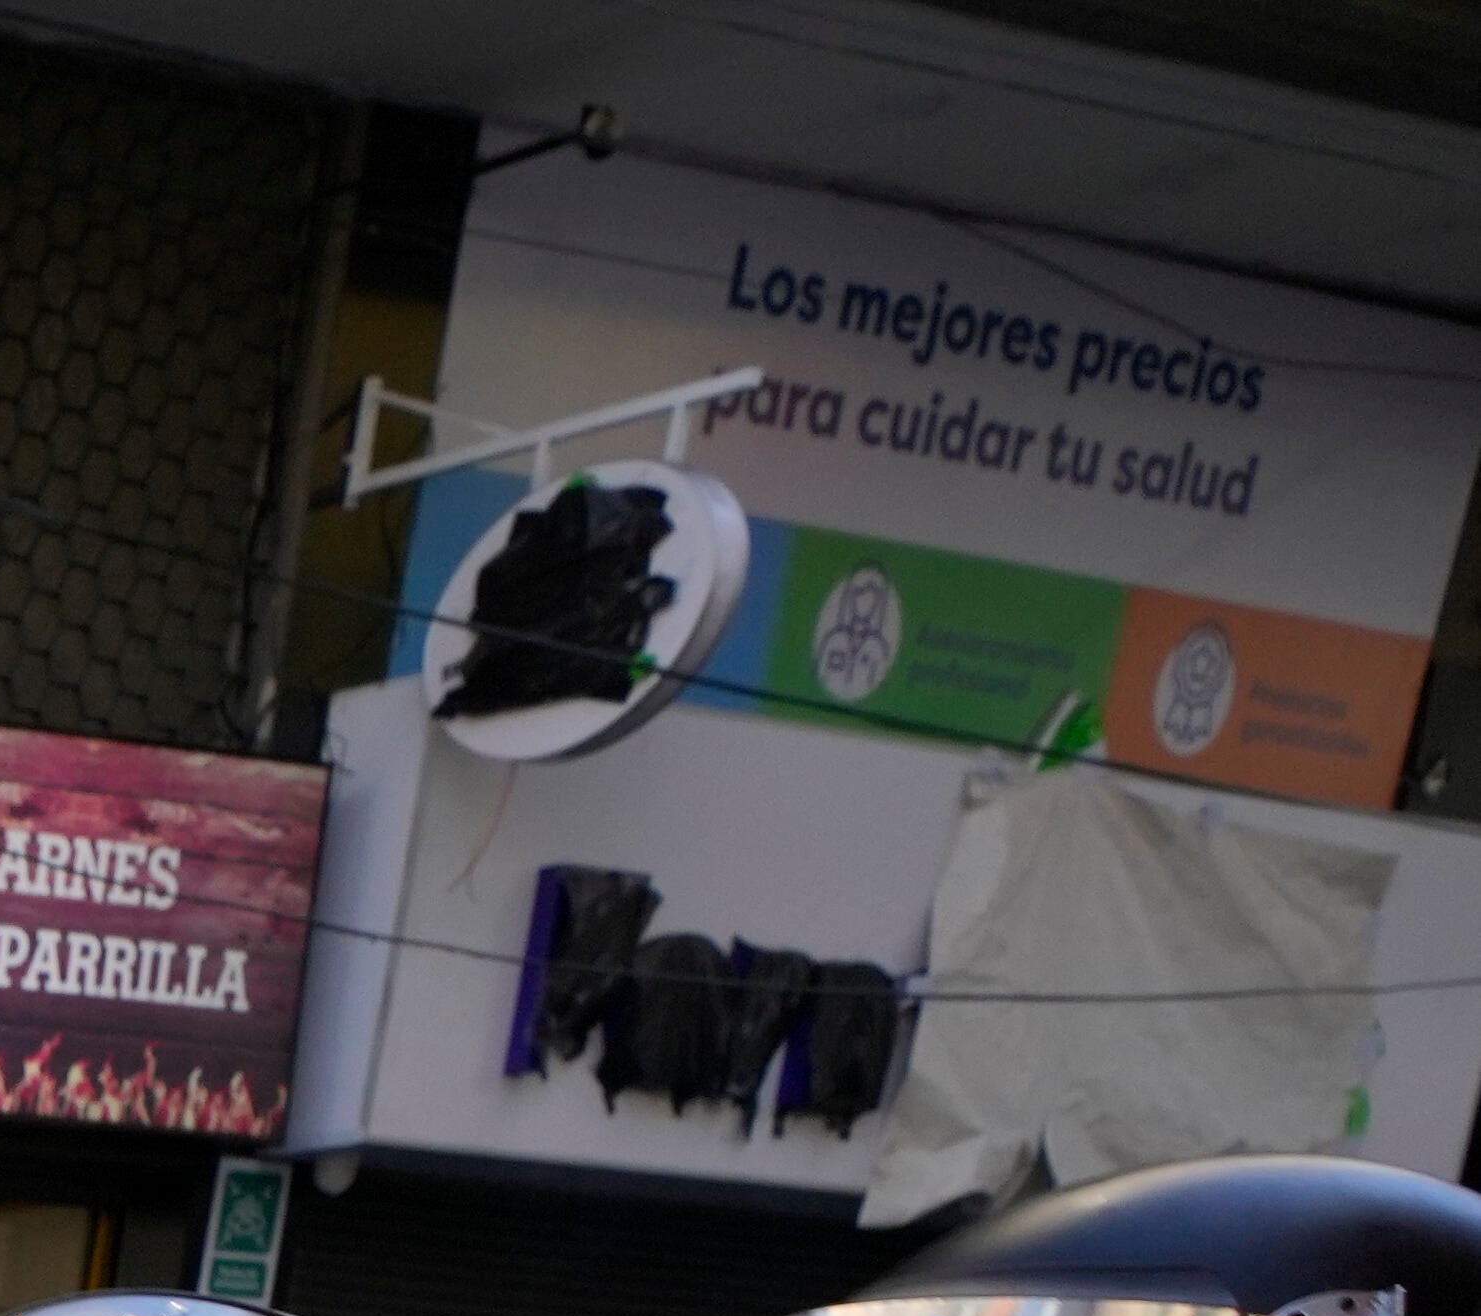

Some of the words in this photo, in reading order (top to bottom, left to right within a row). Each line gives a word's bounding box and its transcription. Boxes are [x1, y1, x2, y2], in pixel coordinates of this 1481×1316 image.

[726, 241, 826, 326] Los
[838, 280, 1061, 368] mejores
[1067, 330, 1267, 414] precios
[699, 366, 846, 440] para
[857, 392, 1038, 475] cuidar
[1046, 424, 1104, 487] tu
[1111, 441, 1261, 518] salud
